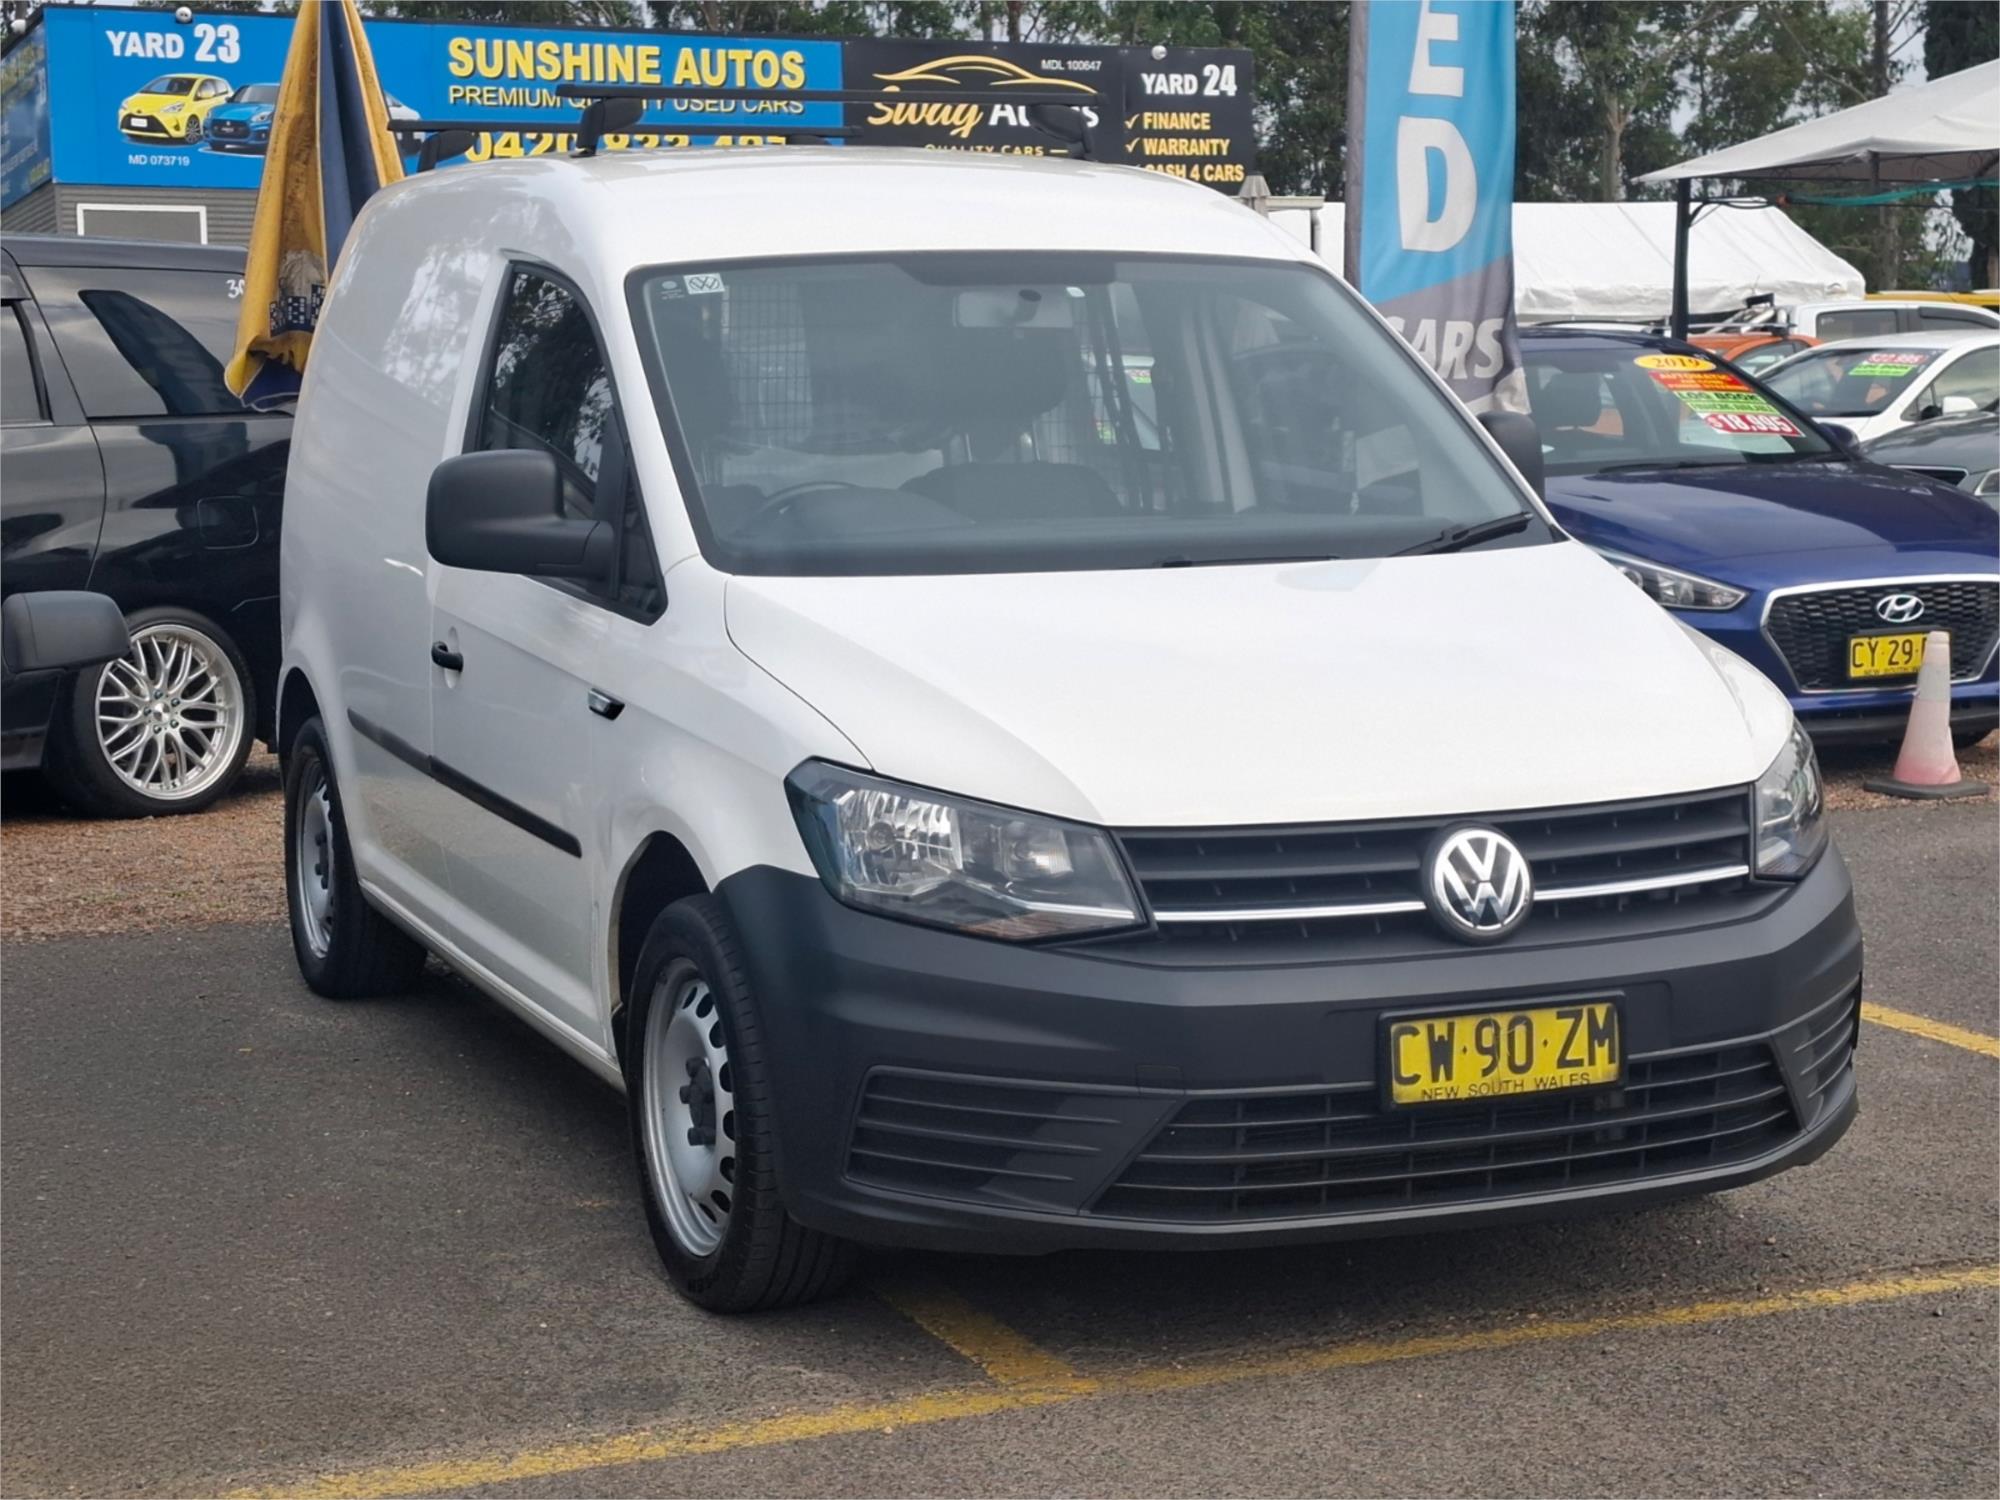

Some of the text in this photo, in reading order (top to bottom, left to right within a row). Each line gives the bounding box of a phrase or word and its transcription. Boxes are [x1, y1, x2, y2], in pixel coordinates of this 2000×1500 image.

[105, 23, 240, 63] YARD 23
[448, 37, 806, 89] SUNSHINE AUTOS
[1041, 59, 1065, 70] MDL
[1141, 64, 1237, 96] YARD 24
[449, 85, 560, 107] PREMIUM
[674, 98, 736, 113] USED
[742, 100, 804, 114] CARS
[867, 86, 984, 138] Sway
[1143, 112, 1211, 130] FINANCE
[1001, 145, 1044, 157] CARS
[1143, 138, 1230, 156] WARRANTY
[128, 155, 190, 166] MD 073719
[1190, 164, 1201, 181] 4
[1203, 164, 1245, 182] CARS
[1652, 357, 1701, 367] 2019
[1706, 413, 1794, 433] $18,995
[1852, 641, 1879, 669] CY
[1888, 639, 1913, 665] 29
[1393, 1006, 1616, 1086] CW 90 ZM
[1421, 1071, 1591, 1100] NEW SOUTH WALES
